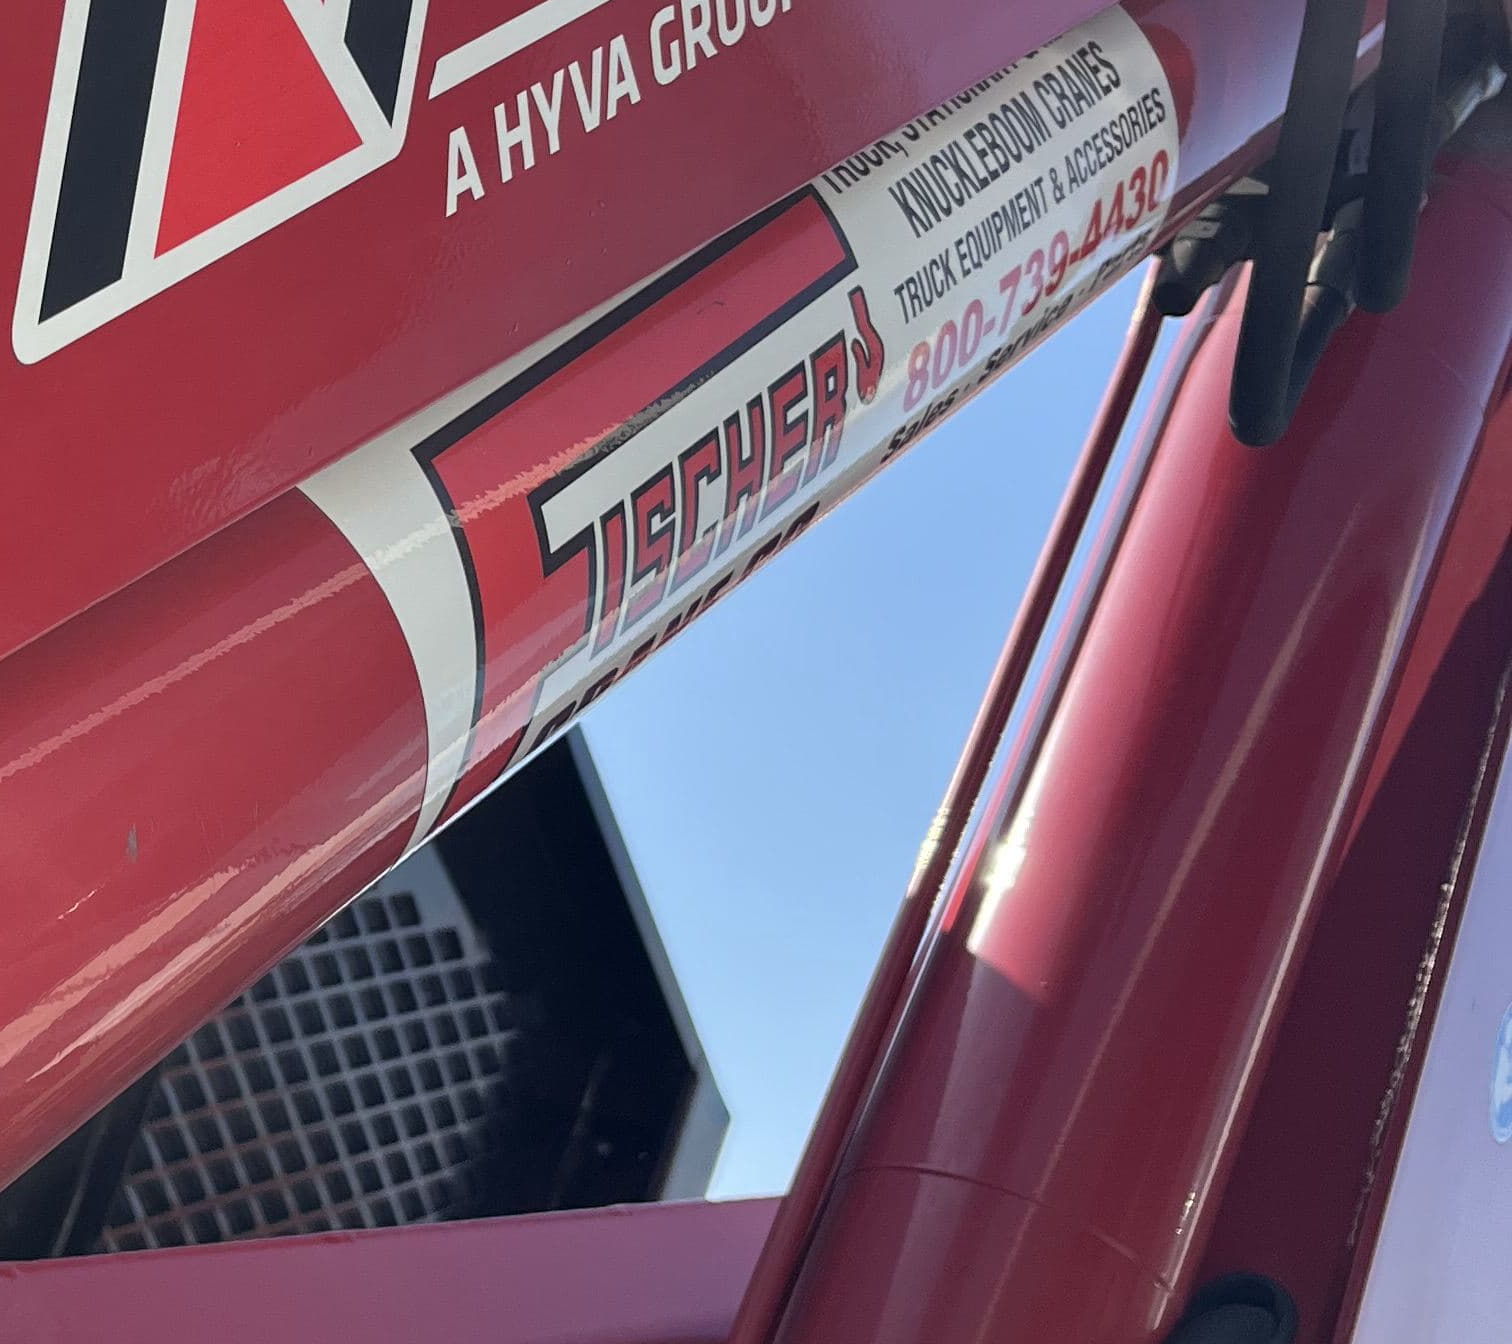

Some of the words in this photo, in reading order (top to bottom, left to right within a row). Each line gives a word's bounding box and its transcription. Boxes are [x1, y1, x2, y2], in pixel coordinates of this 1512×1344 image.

[445, 126, 485, 218] A
[493, 33, 642, 184] HYVA
[888, 90, 1051, 239] KNUCKLEBOOM
[1033, 40, 1121, 130] CRANES
[893, 247, 959, 325] TRUCK
[954, 176, 1050, 279] EQUIPMENT
[1049, 167, 1066, 205] &
[1064, 86, 1167, 194] ACCESSORIES
[879, 387, 960, 465] Sales
[977, 293, 1074, 385] Service
[902, 149, 1170, 413] 800-739-4430
